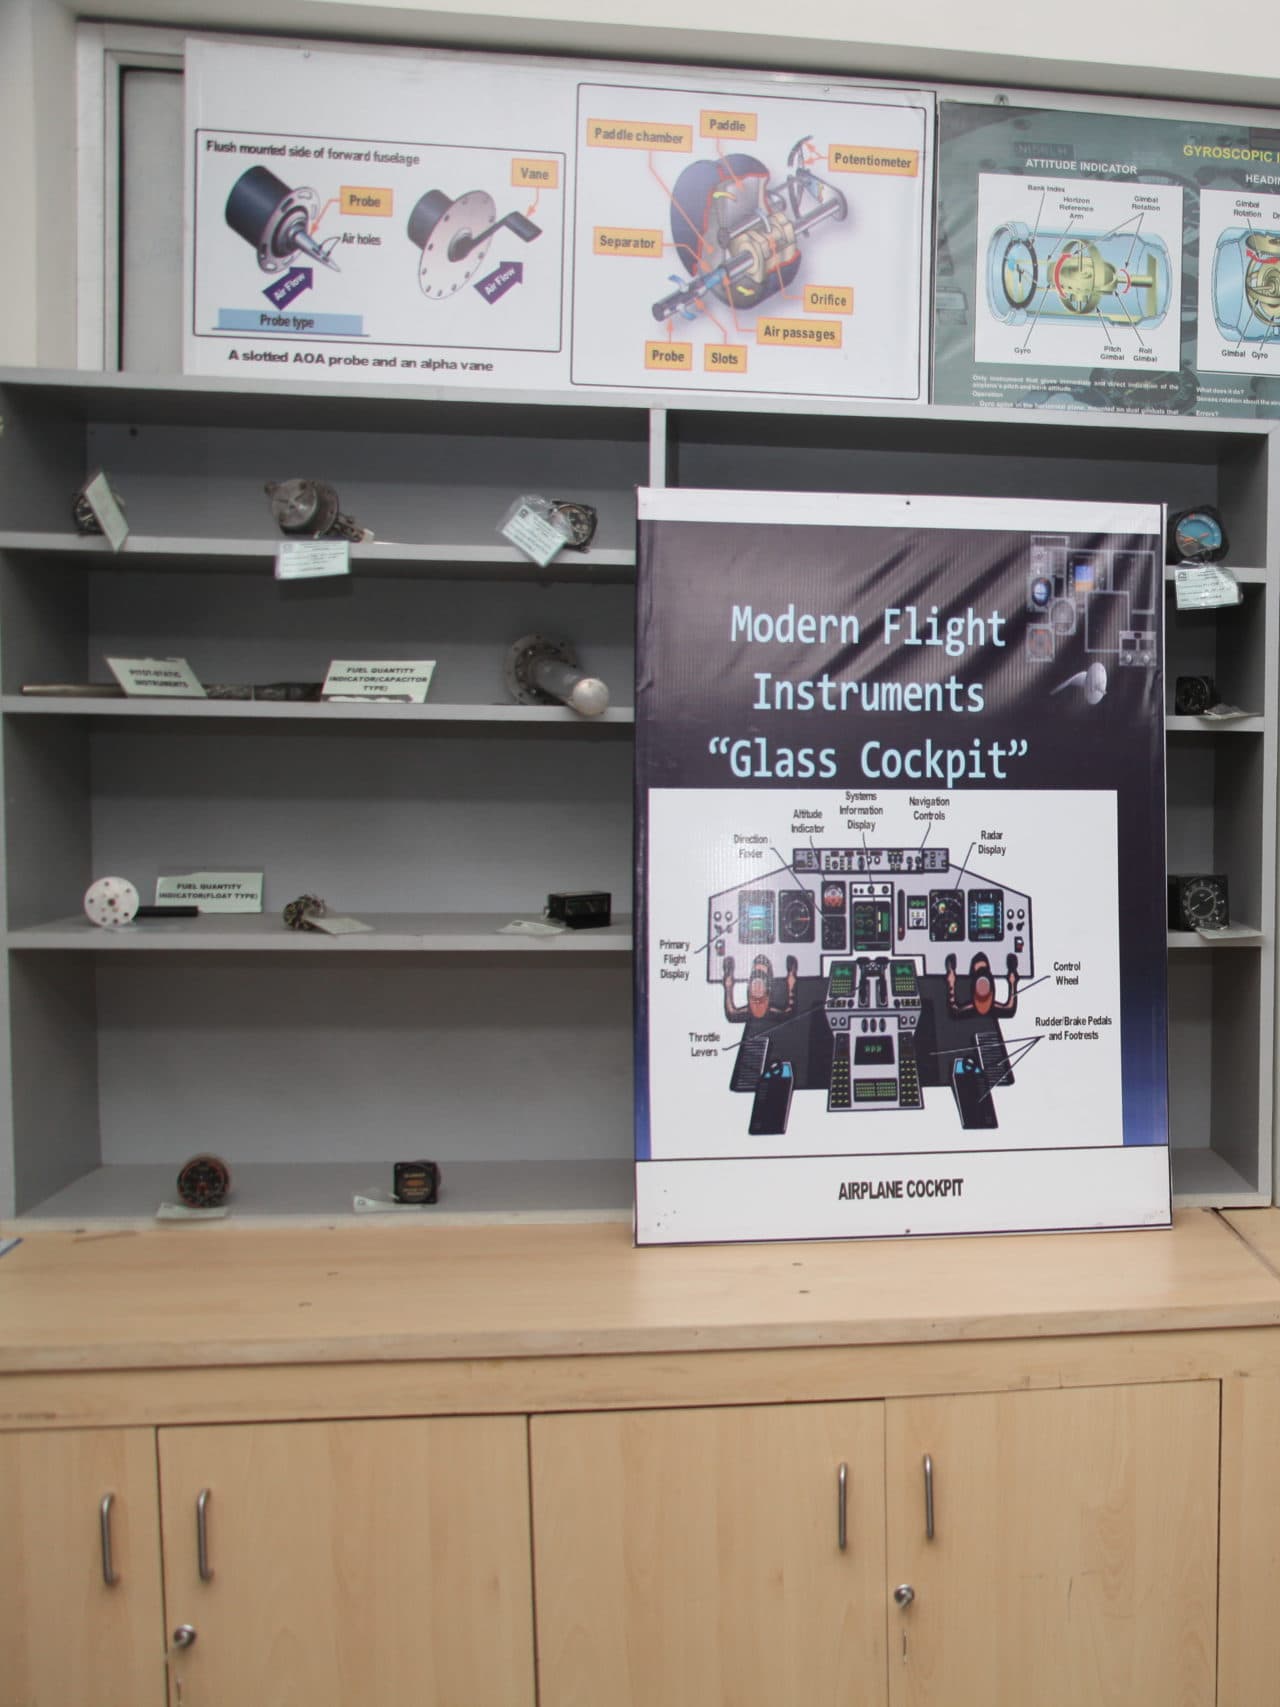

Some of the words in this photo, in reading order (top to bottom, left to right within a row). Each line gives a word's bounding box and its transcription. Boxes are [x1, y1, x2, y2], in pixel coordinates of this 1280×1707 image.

[709, 118, 746, 132] Paddle
[594, 127, 634, 141] Paddle
[636, 129, 684, 145] chamber
[206, 140, 236, 154] Flush
[239, 145, 286, 157] mounted
[288, 146, 312, 158] side
[313, 147, 325, 158] of
[328, 148, 370, 162] forward
[373, 150, 420, 167] fuselage
[1183, 144, 1273, 163] GYROSCOPIC
[833, 152, 913, 169] Potentiometer
[1025, 158, 1077, 171] ATTITUDE
[1079, 161, 1138, 175] INDICATOR
[520, 166, 549, 180] Vane
[1027, 184, 1046, 193] Bank
[1046, 186, 1066, 194] Index
[349, 194, 380, 208] Probe
[1063, 196, 1091, 205] Horizon
[1134, 195, 1159, 204] Gimbal
[1235, 199, 1259, 210] Gimbal
[1059, 203, 1095, 213] Reference
[1131, 203, 1161, 212] Rotation
[1233, 208, 1262, 218] Rotation
[1069, 212, 1085, 220] Arm
[341, 233, 355, 246] Air
[357, 233, 381, 246] holes
[599, 235, 656, 252] Separator
[274, 286, 286, 301] Air
[284, 273, 306, 292] Flow
[484, 280, 497, 297] Air
[496, 268, 516, 287] Flow
[810, 293, 848, 307] Orifice
[260, 313, 290, 328] Probe
[293, 316, 315, 330] type
[763, 324, 780, 338] Air
[782, 326, 836, 342] passages
[1014, 346, 1032, 356] Gyro
[1104, 344, 1122, 354] Pitch
[1138, 347, 1153, 355] Roll
[1221, 349, 1246, 358] Gimbal
[228, 350, 240, 361] A
[242, 350, 289, 363] slotted
[293, 352, 325, 364] AOA
[329, 354, 369, 369] probe
[372, 356, 397, 368] and
[400, 359, 417, 369] an
[420, 358, 458, 372] alpha
[460, 361, 494, 372] vane
[652, 349, 685, 364] Probe
[711, 351, 739, 366] Slots
[1100, 353, 1125, 362] Gimbal
[1133, 354, 1159, 363] Gimbal
[1251, 351, 1268, 360] Gyro
[730, 604, 860, 645] Modern
[883, 606, 1007, 657] Flight
[370, 667, 416, 675] QUANTITY
[134, 678, 189, 688] INSTRUMENTS
[753, 672, 985, 713] Instruments
[845, 791, 877, 802] Systems
[909, 796, 950, 808] Navigation
[839, 805, 883, 816] Information
[913, 810, 945, 821] Controls
[791, 823, 824, 834] Indicator
[847, 820, 876, 832] Display
[734, 834, 768, 845] Direction
[981, 829, 1003, 840] Radar
[739, 848, 763, 859] Finder
[978, 844, 1006, 856] Display
[659, 939, 690, 951] Primary
[664, 954, 686, 966] Flight
[1053, 961, 1081, 971] Control
[660, 969, 690, 981] Display
[1055, 975, 1079, 985] Wheel
[1088, 1016, 1112, 1025] Pedals
[688, 1032, 720, 1042] Throttle
[1048, 1031, 1062, 1040] and
[1064, 1031, 1099, 1040] Footrests
[691, 1047, 718, 1057] Levers
[838, 1180, 904, 1200] AIRPLANE
[906, 1178, 964, 1198] COCKPIT
